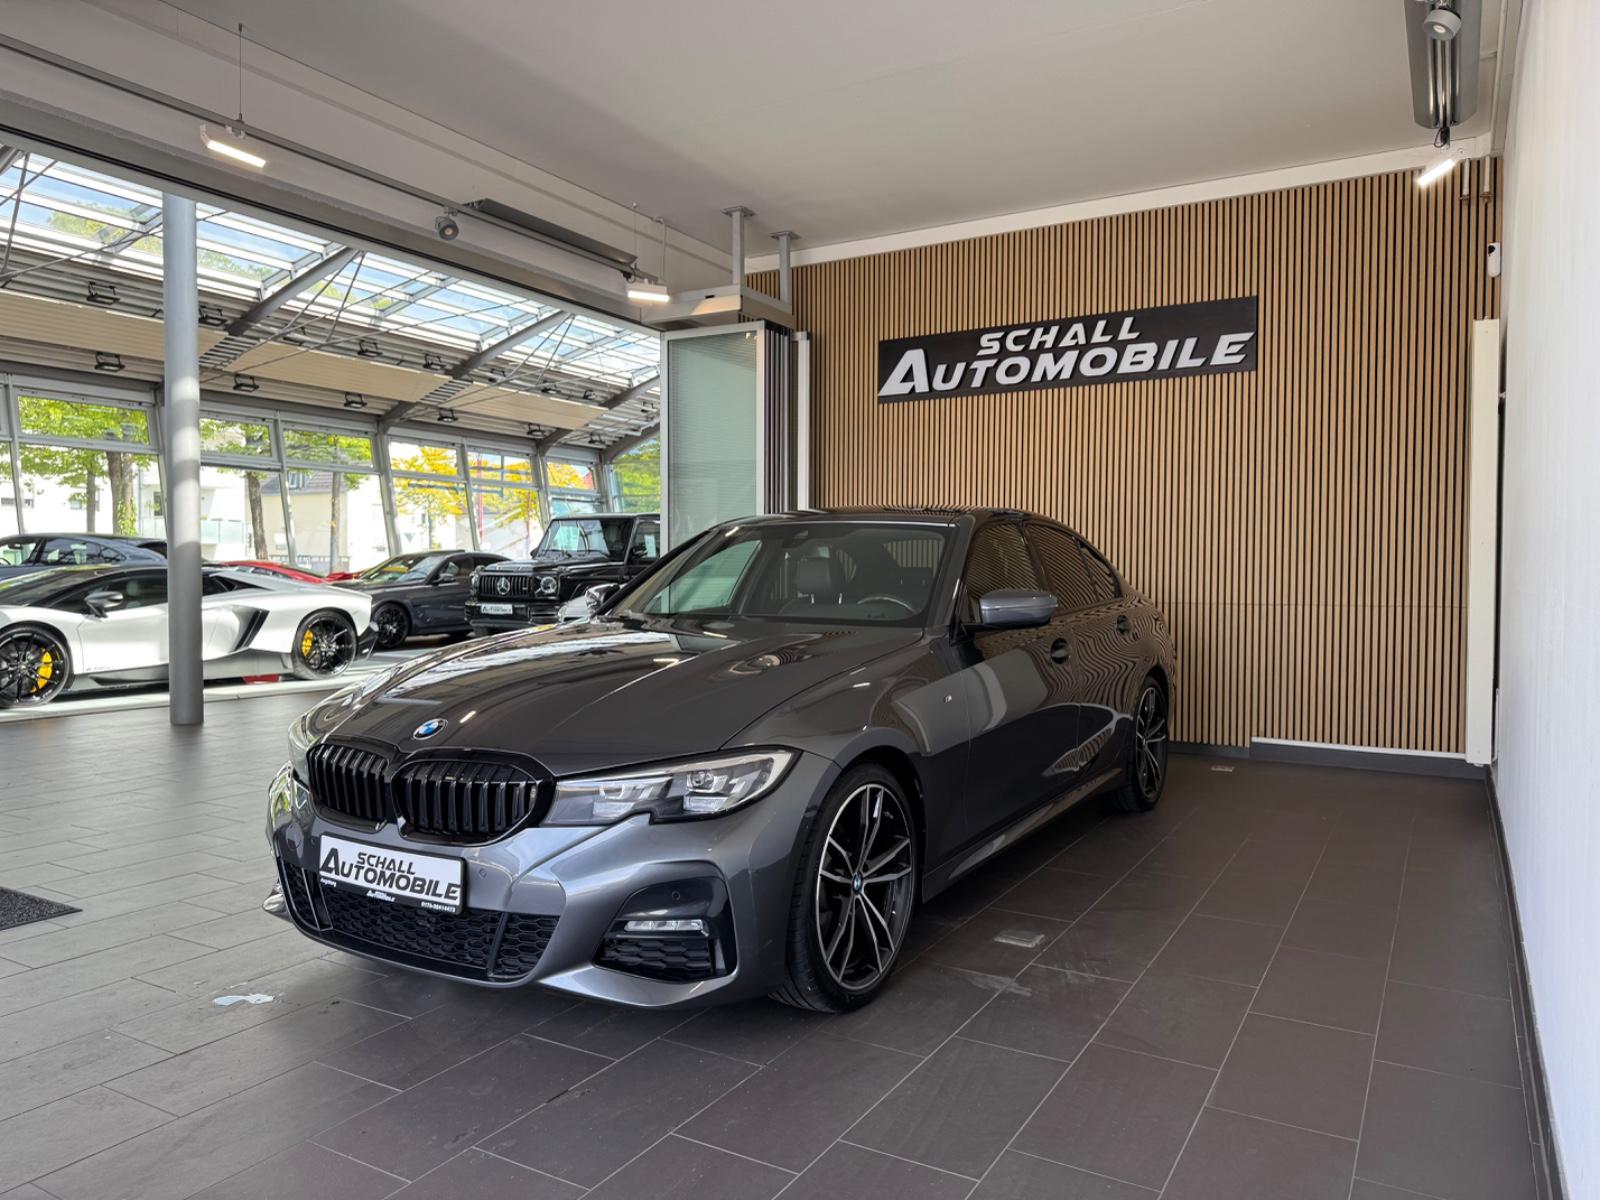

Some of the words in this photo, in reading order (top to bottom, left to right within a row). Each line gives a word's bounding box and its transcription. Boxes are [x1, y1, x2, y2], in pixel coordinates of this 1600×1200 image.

[976, 316, 1142, 356] SCHALL
[877, 331, 1255, 397] AUTOMOBILE
[320, 847, 461, 901] AUTOMOBILE
[356, 852, 416, 875] SCHALL
